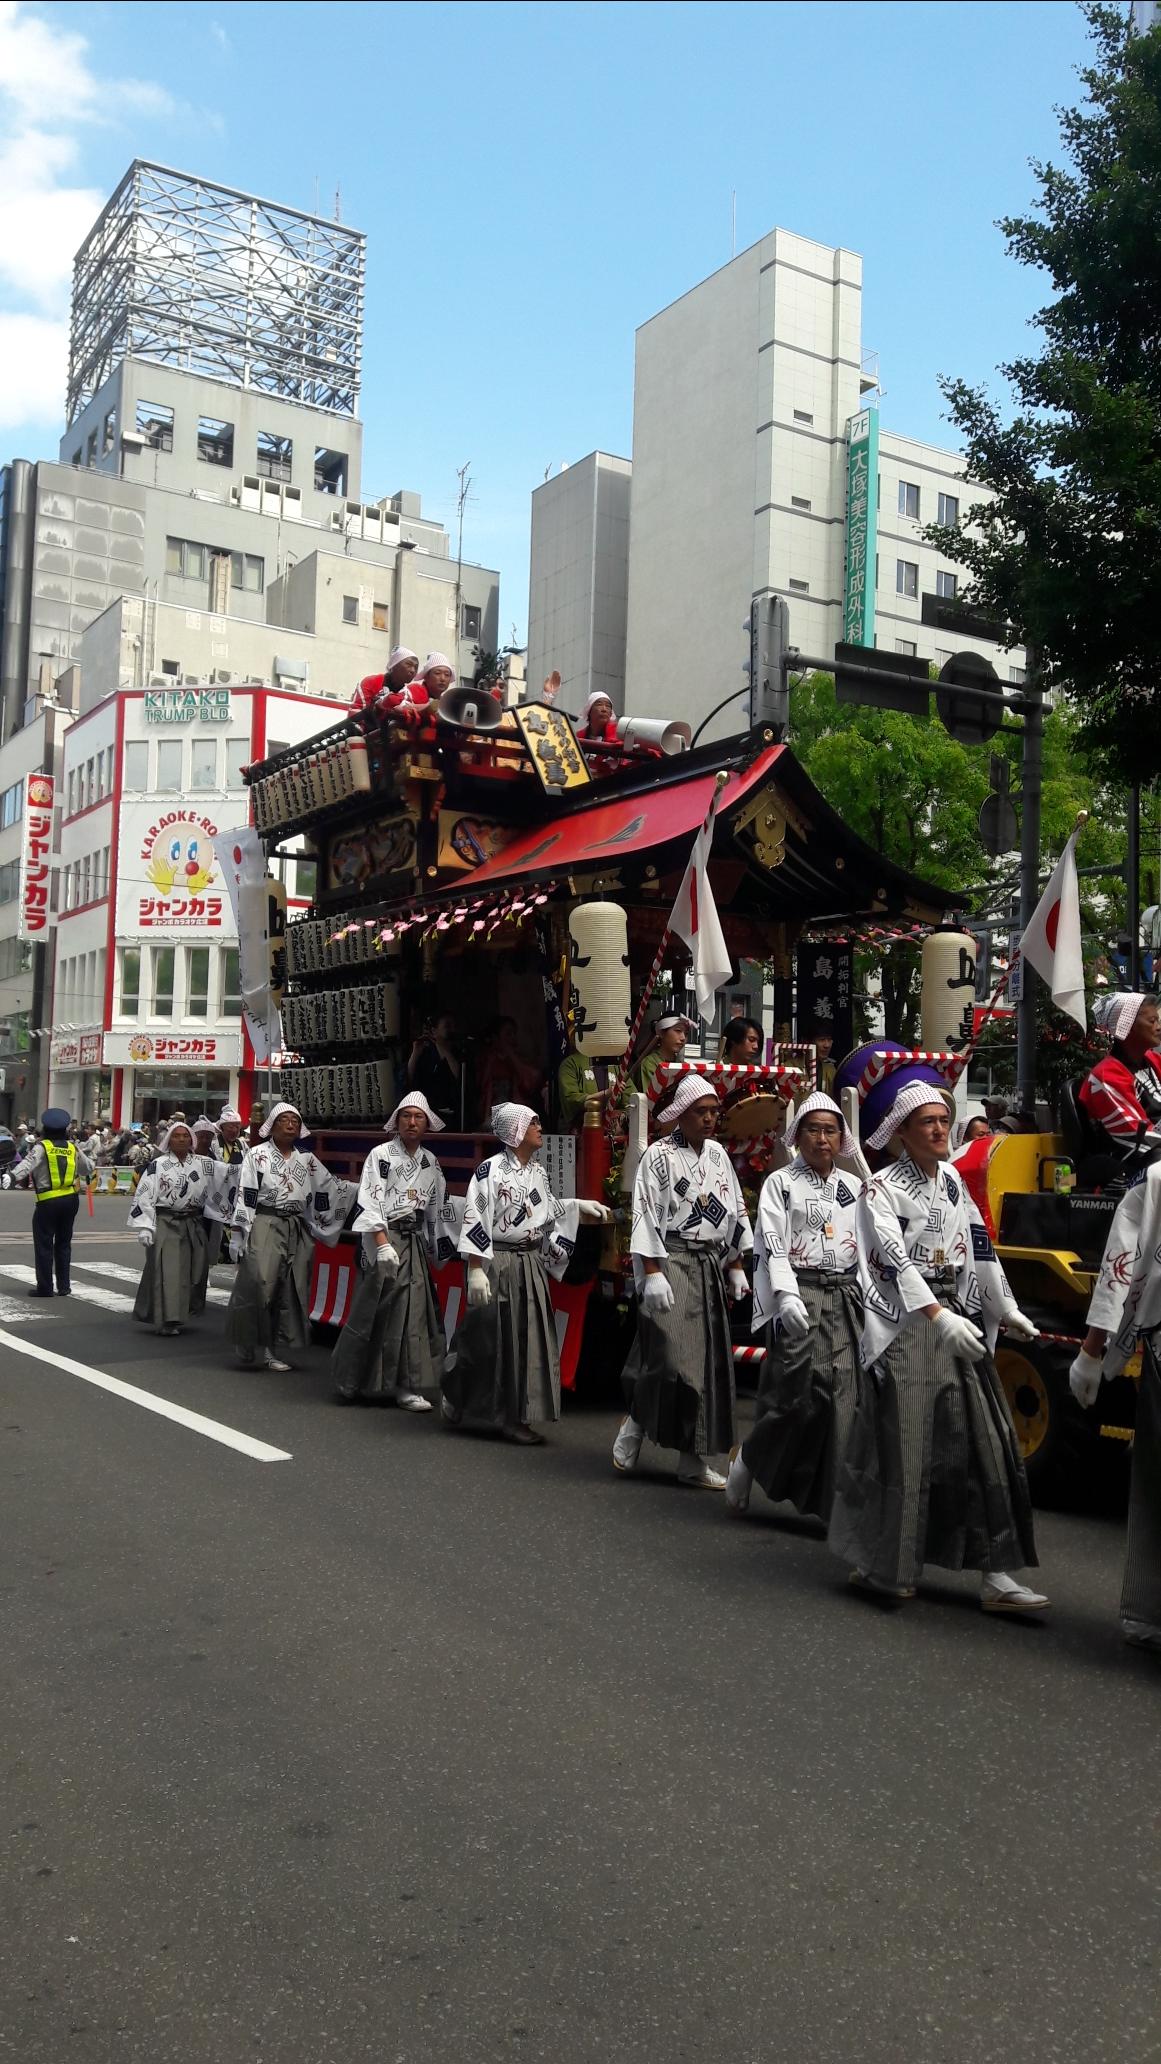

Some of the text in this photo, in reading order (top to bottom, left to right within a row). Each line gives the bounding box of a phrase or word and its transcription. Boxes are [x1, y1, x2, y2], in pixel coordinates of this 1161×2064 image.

[852, 417, 868, 437] 7F
[847, 449, 868, 644] 大塚美容形成外科
[144, 690, 229, 707] KITAKO
[145, 707, 232, 721] TRUMP BLD.
[24, 815, 51, 931] ジャンカラ
[139, 897, 222, 917] ジャンカラ
[155, 1038, 216, 1053] ジャンカラ
[1070, 1199, 1115, 1211] YANMAR
